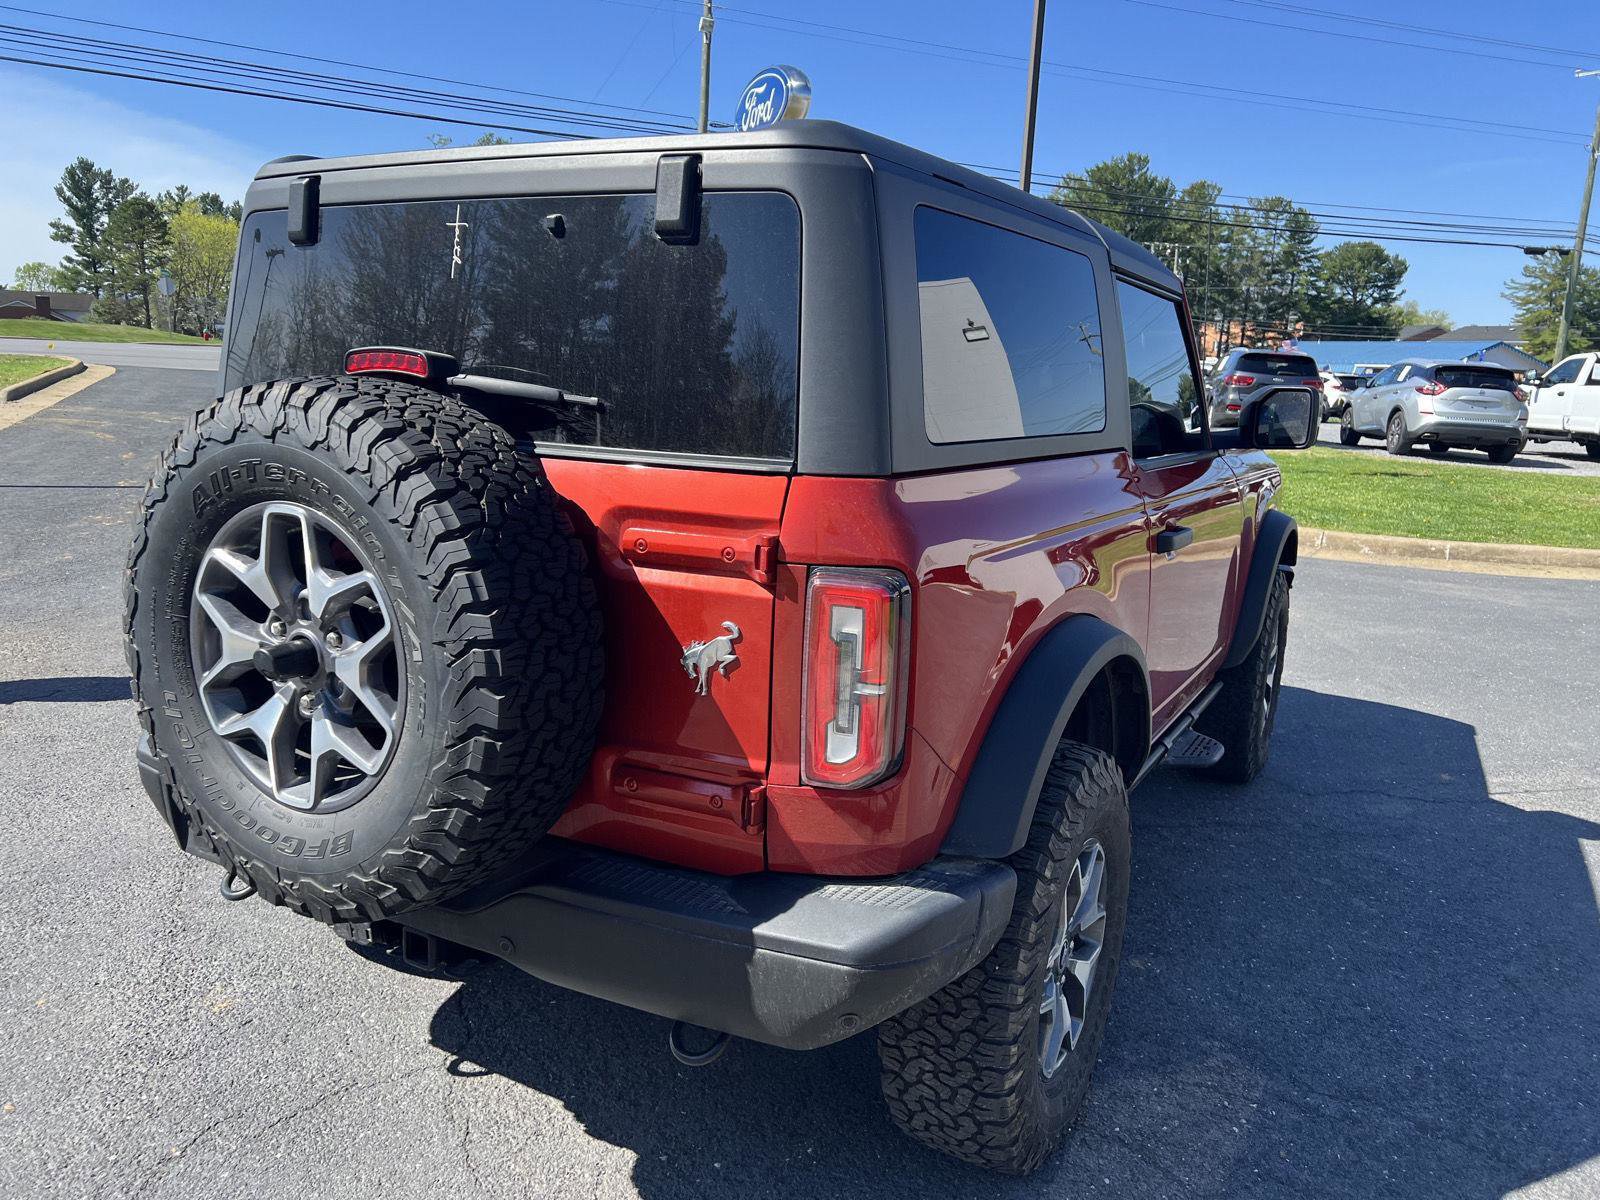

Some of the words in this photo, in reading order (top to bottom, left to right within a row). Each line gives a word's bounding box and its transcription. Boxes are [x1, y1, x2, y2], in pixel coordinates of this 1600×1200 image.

[742, 82, 776, 132] Ford
[446, 204, 469, 279] faith
[191, 457, 388, 562] All-Terrain
[162, 689, 354, 861] BFGoodrich
